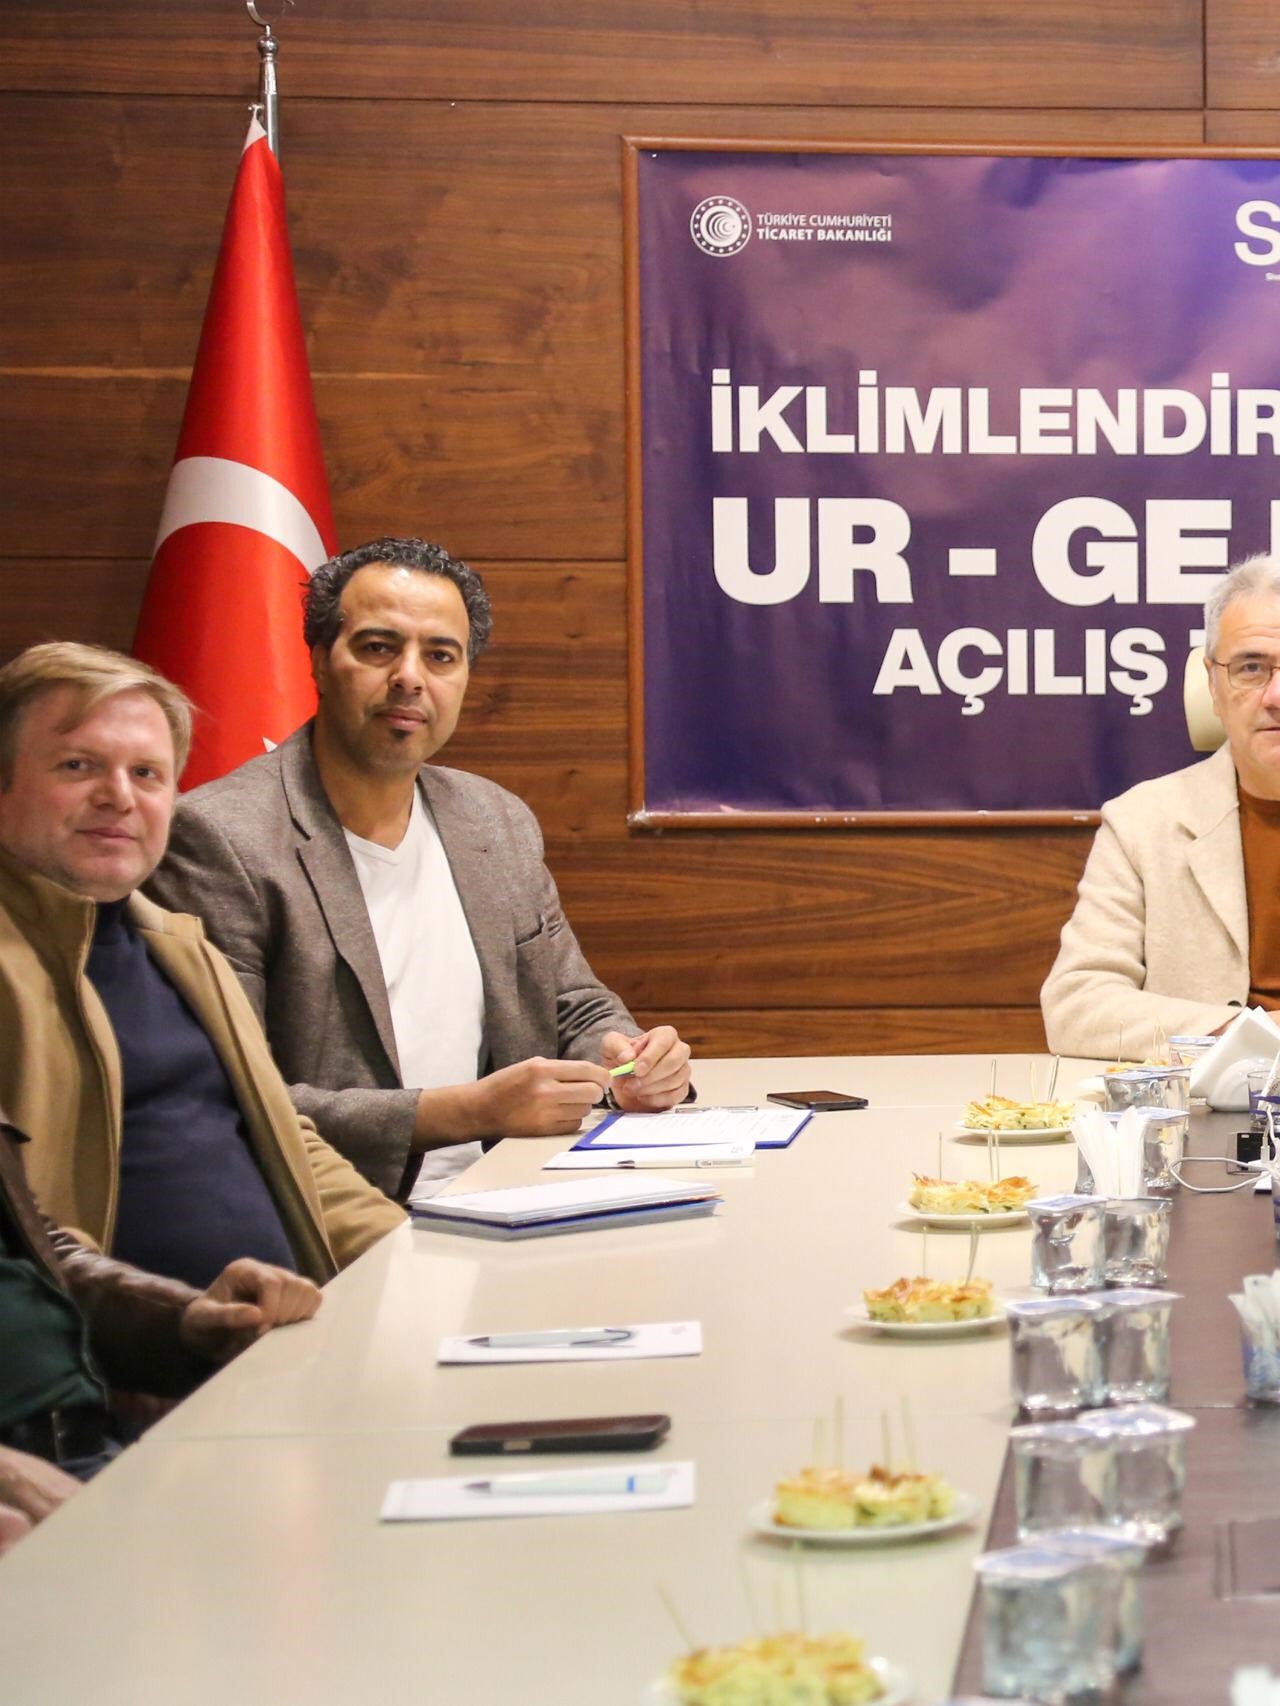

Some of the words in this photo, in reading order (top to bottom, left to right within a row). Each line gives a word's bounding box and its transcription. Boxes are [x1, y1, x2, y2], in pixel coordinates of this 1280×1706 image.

[757, 213, 806, 226] TÜRKİYE
[809, 214, 892, 227] CUMHURİYETİ
[757, 227, 813, 240] TİCARET
[817, 228, 892, 241] BAKANLIĞI
[712, 497, 914, 606] UR
[1031, 496, 1232, 607] GE
[872, 627, 1168, 716] AÇILIŞ
